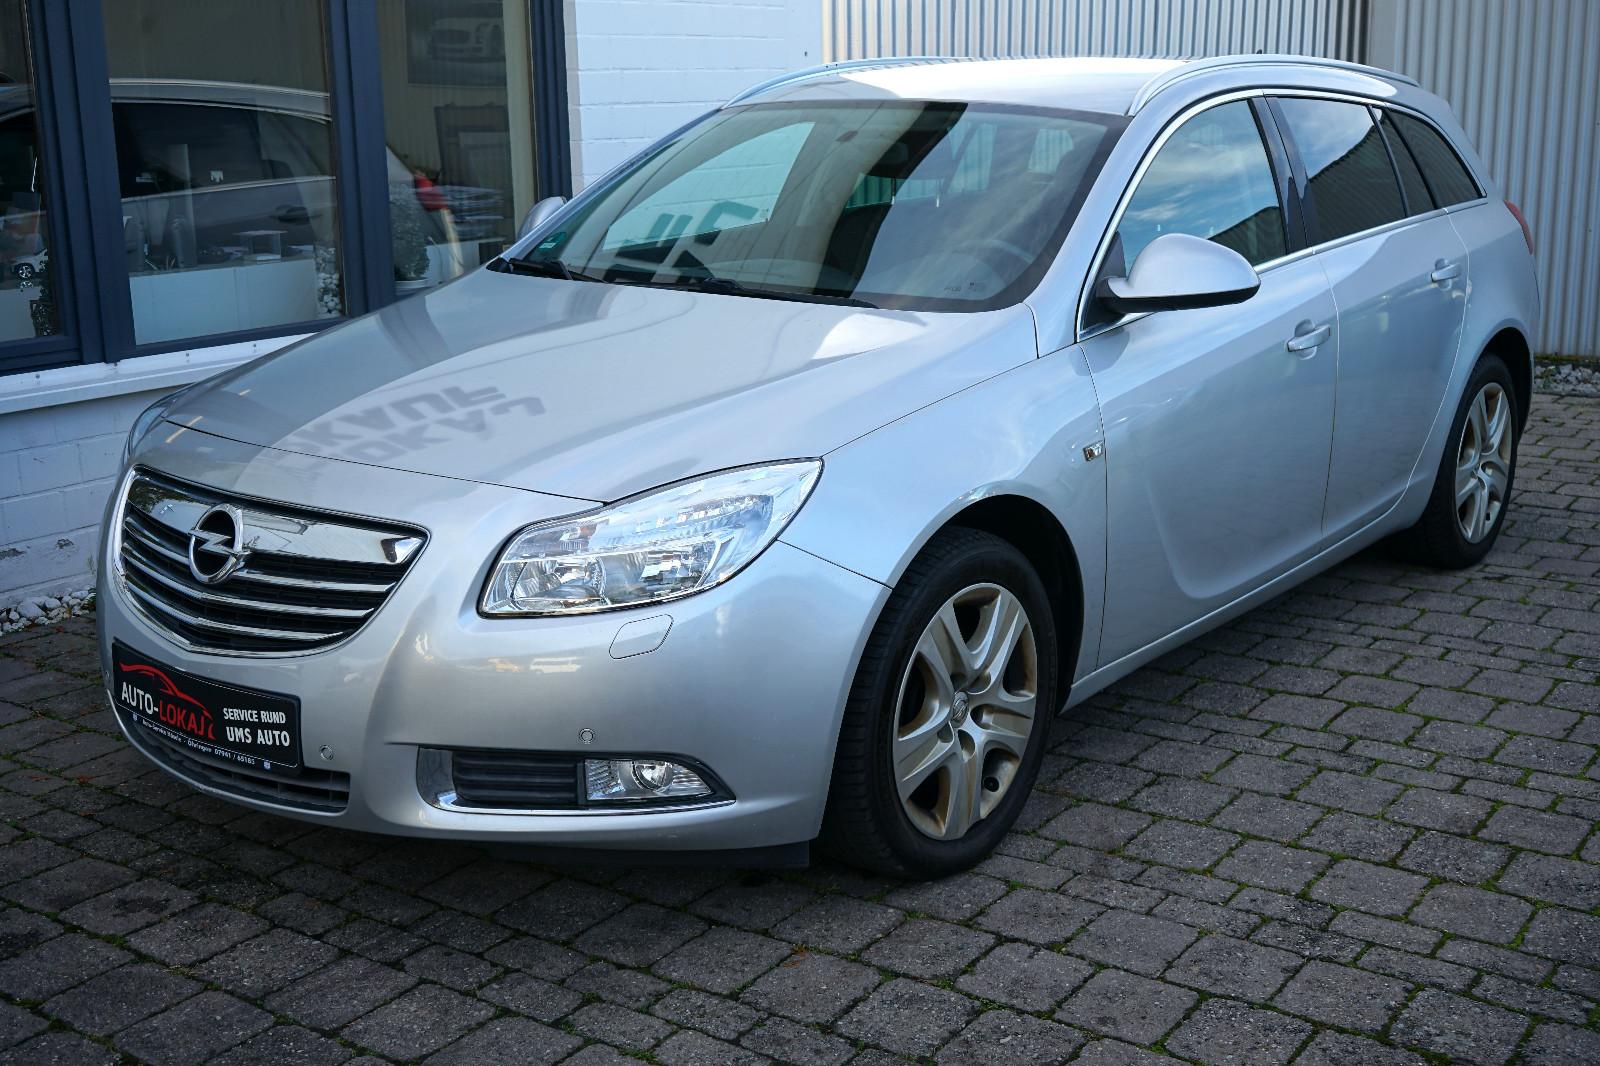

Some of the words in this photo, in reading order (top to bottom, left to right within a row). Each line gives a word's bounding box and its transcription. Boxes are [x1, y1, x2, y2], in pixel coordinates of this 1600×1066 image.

[223, 707, 258, 722] SERVICE
[260, 710, 286, 723] RUND
[226, 726, 252, 743] UMS
[257, 729, 290, 747] AUTO
